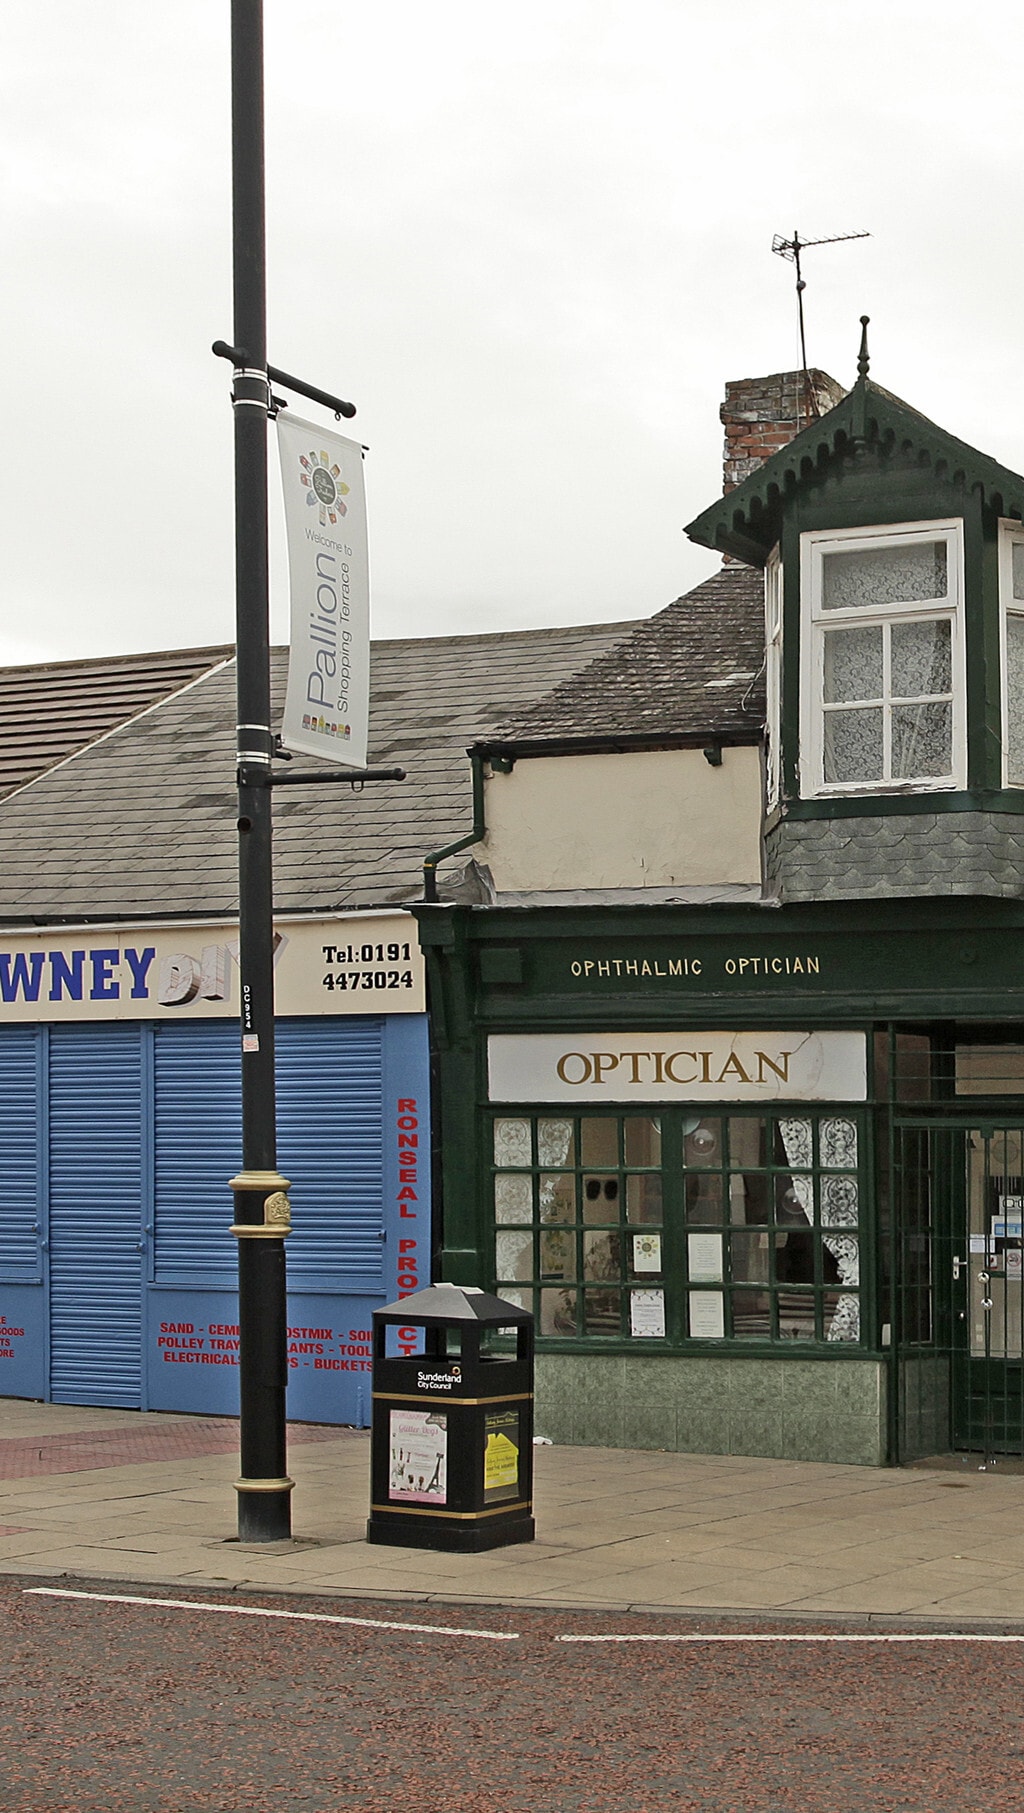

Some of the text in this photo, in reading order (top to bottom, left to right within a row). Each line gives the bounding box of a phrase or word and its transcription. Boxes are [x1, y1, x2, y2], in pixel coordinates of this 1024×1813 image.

[305, 528, 353, 556] Welcome to
[307, 552, 337, 709] Pallion
[337, 562, 352, 713] Shopping Terrace
[322, 943, 411, 964] Tel:0191
[571, 956, 820, 977] OPHTHALMIC OPTICIAN
[322, 970, 413, 991] 4473024
[243, 985, 251, 1028] DC954
[556, 1051, 792, 1085] OPTICIAN
[397, 1098, 418, 1356] RONSEAL PROCT
[0, 1328, 25, 1336] OODS
[160, 1322, 194, 1334] SAND
[286, 1327, 333, 1340] OSTMIX
[157, 1336, 204, 1349] POLLEY
[417, 1371, 462, 1383] Sunderland
[417, 1380, 452, 1389] City Council
